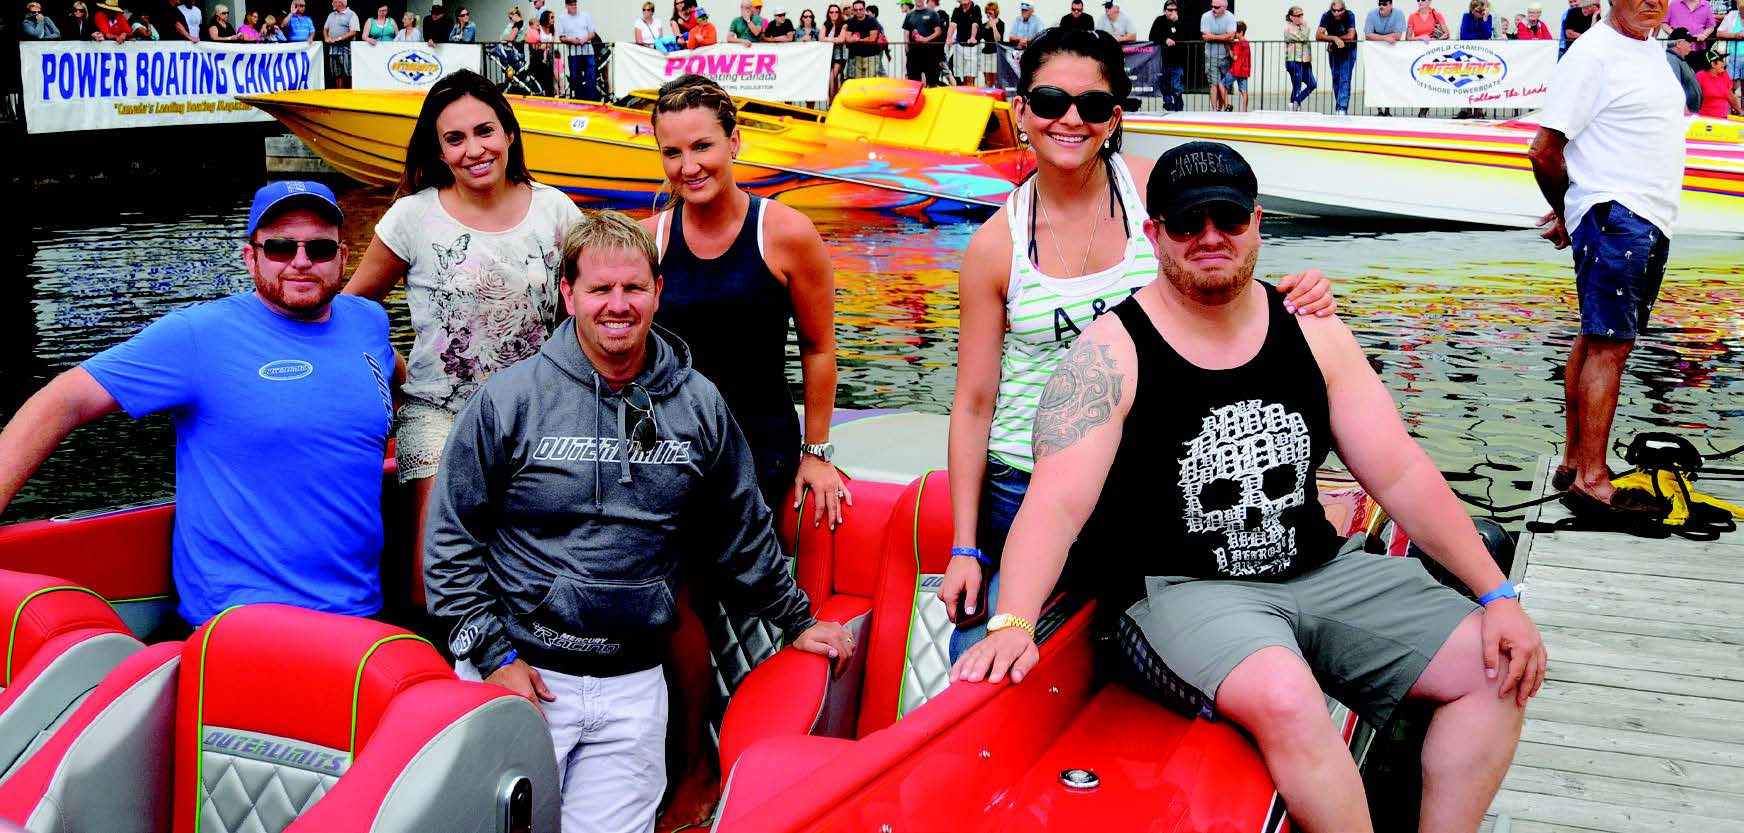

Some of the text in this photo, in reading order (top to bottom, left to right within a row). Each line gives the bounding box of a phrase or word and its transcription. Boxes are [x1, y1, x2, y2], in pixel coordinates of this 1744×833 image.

[41, 51, 311, 100] POWER BOATING CANADA
[664, 53, 777, 77] POWER
[740, 71, 777, 81] Canada
[1468, 82, 1548, 105] Follow The Leade
[1053, 307, 1082, 342] A
[560, 632, 609, 645] MERCURY
